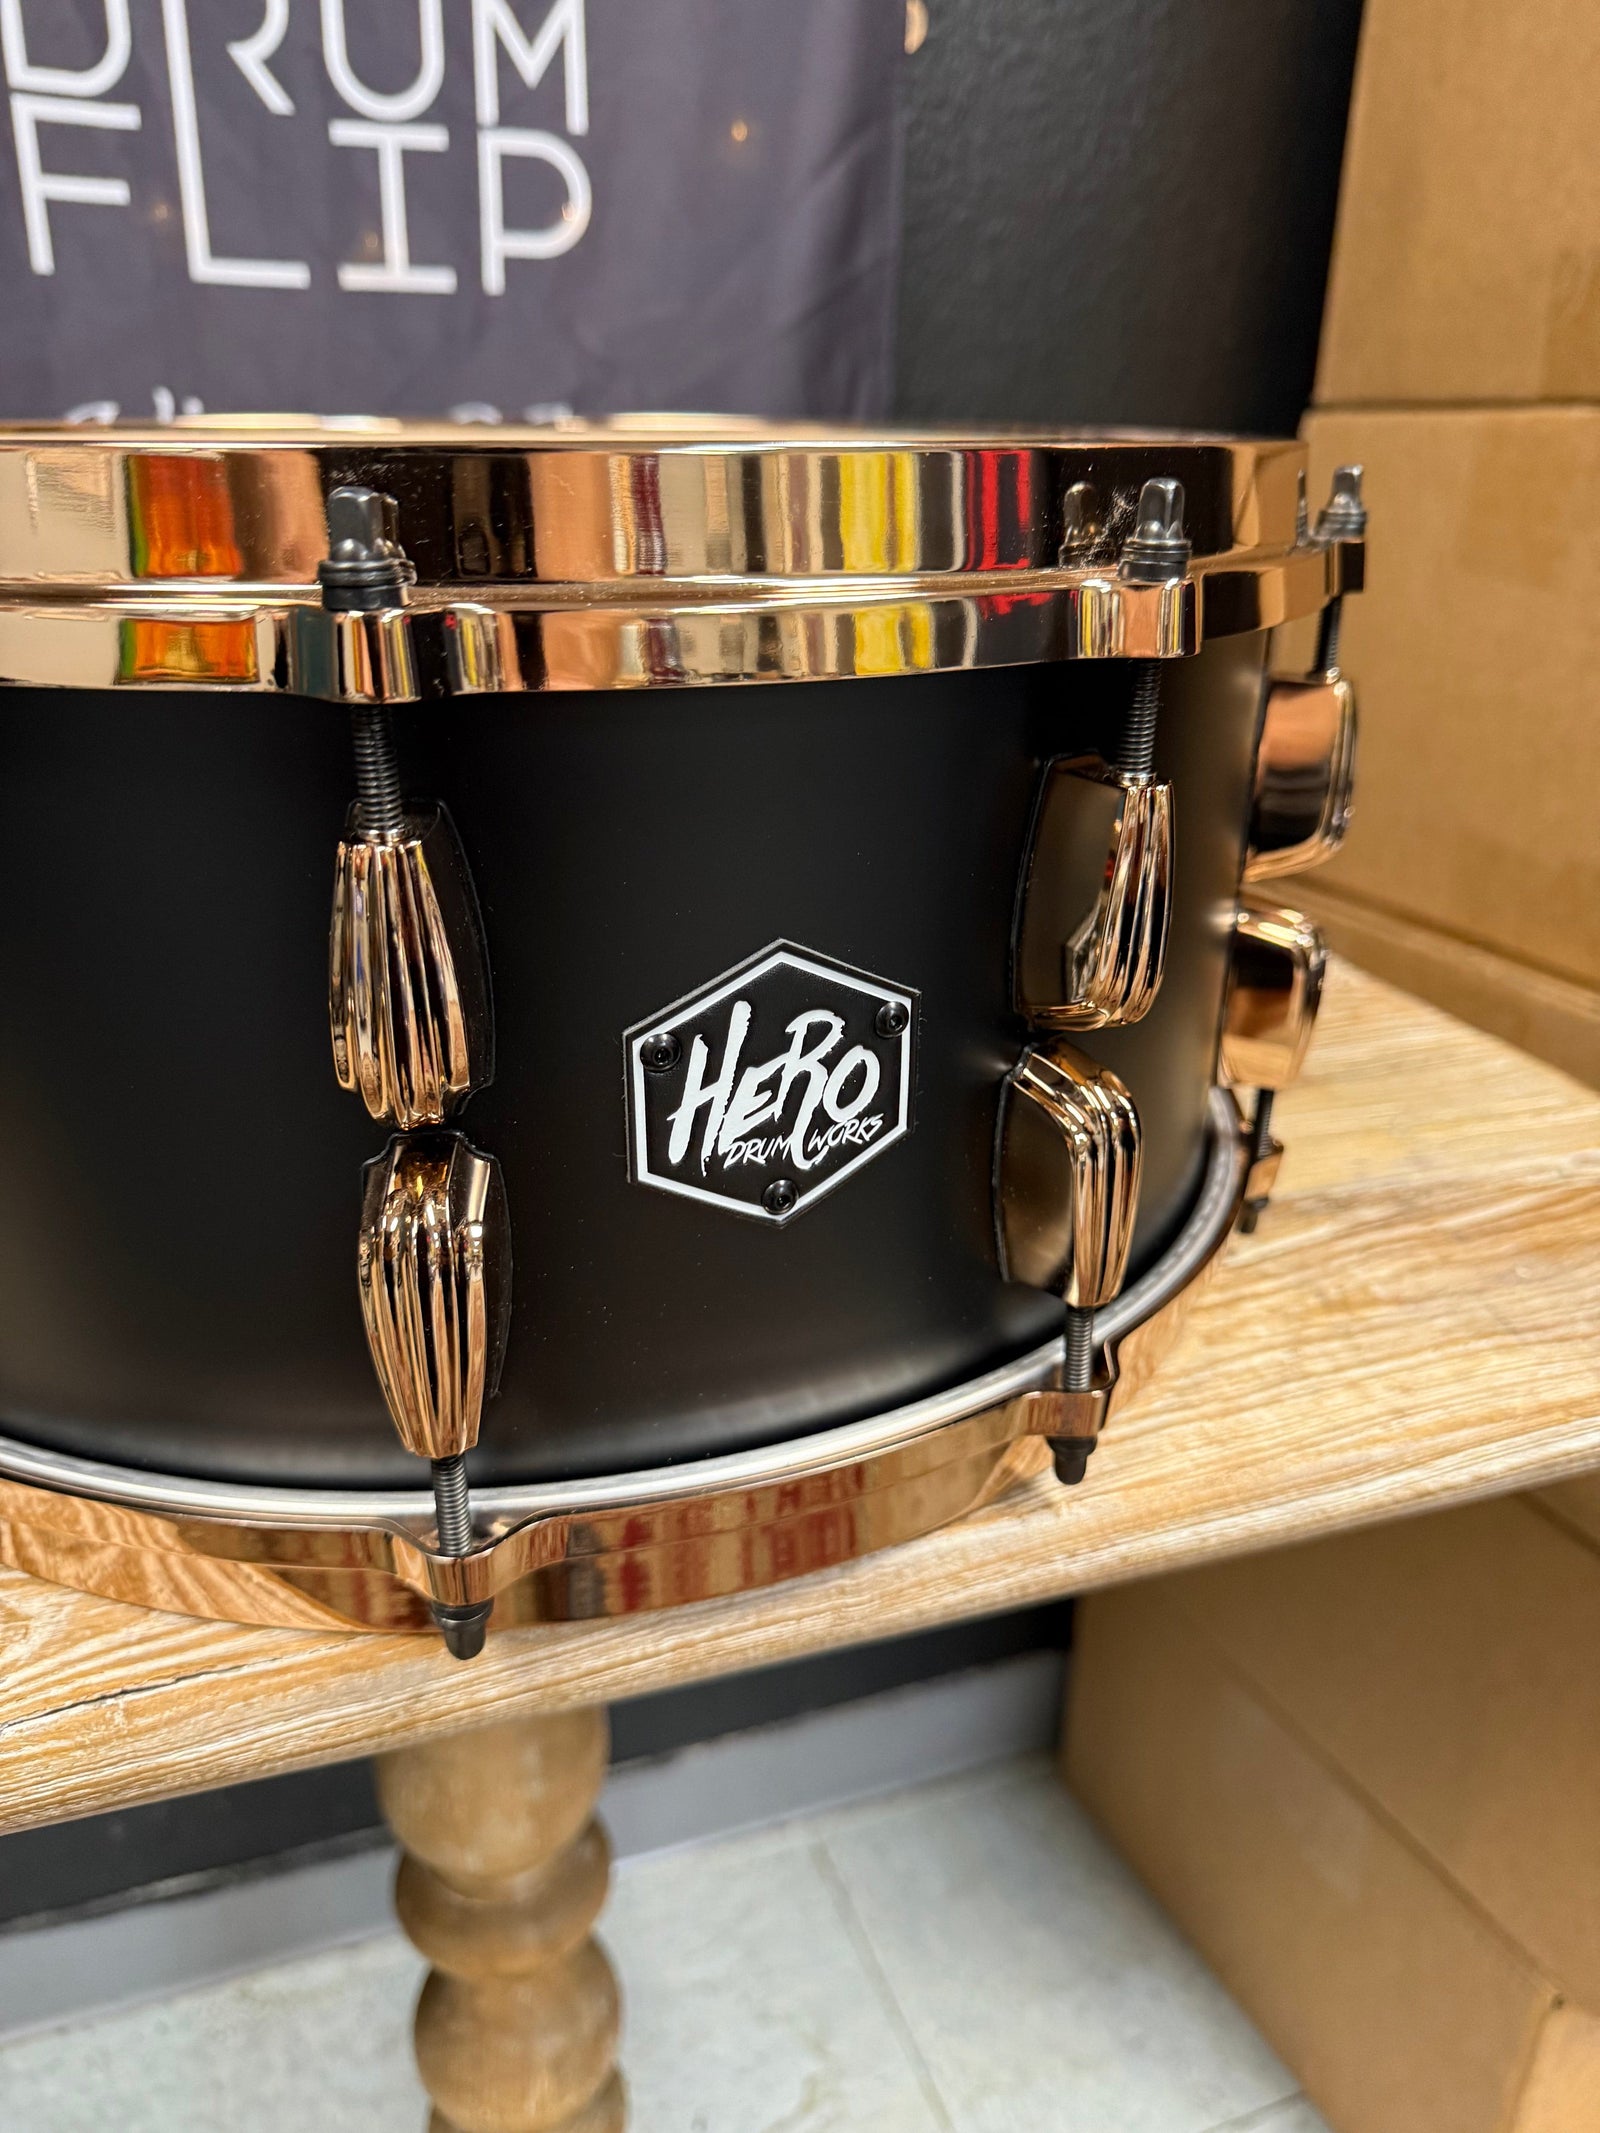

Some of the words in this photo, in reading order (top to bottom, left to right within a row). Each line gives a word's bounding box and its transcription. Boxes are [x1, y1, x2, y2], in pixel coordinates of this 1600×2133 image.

[10, 93, 593, 296] FLIP
[723, 1135, 793, 1169] DRUM
[807, 1113, 884, 1152] WORKS
